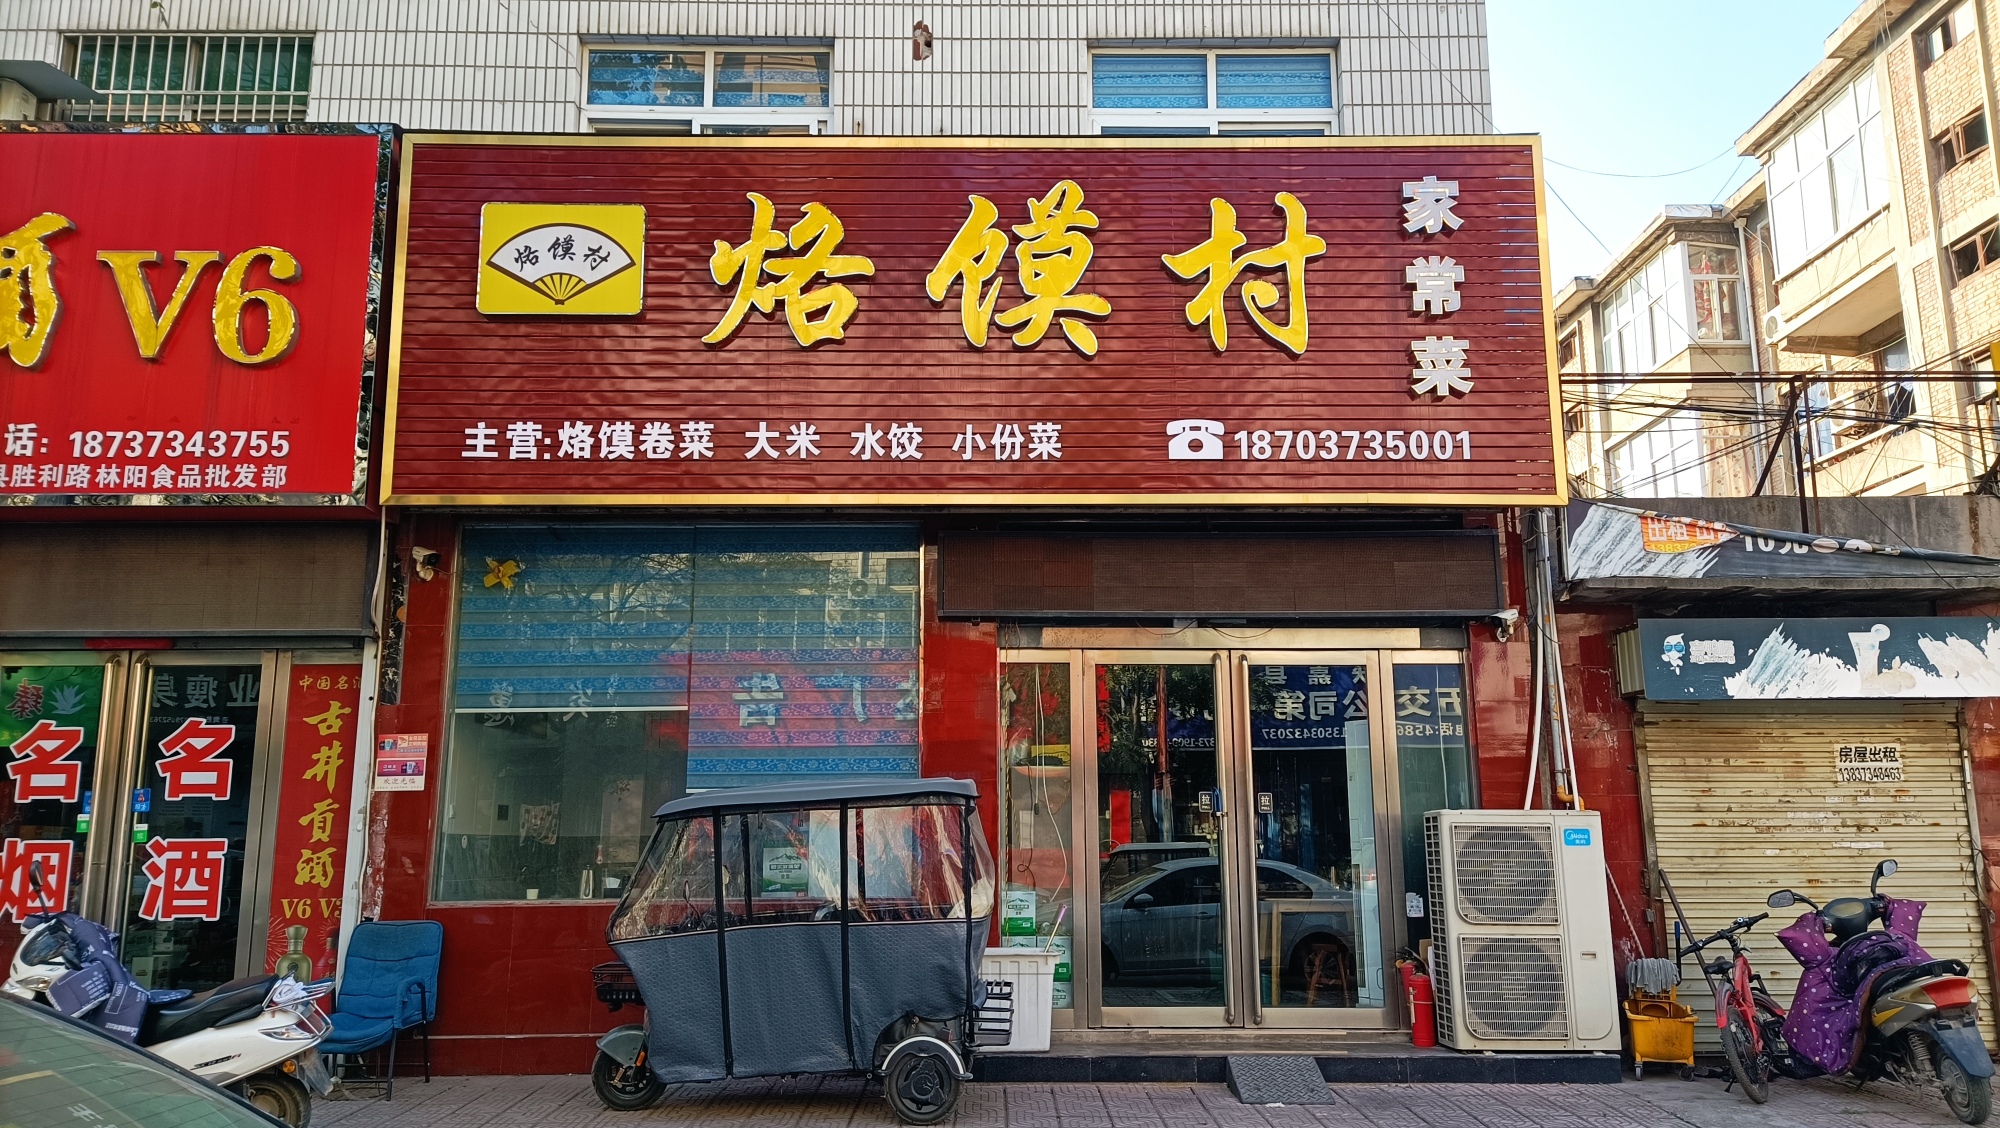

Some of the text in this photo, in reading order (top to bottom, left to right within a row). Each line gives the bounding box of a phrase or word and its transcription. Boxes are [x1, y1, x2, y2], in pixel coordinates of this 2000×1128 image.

[701, 179, 1327, 356] 烙馍村
[1402, 176, 1474, 397] 家常菜
[96, 245, 302, 366] V6
[69, 430, 290, 459] 18737343755
[744, 421, 821, 461] 大米
[850, 421, 924, 461] 水饺
[952, 421, 1063, 461] 小份菜
[1234, 429, 1472, 461] 18703735001
[1839, 746, 1898, 763] 房屋出租
[1839, 766, 1902, 782] 13837348463
[1201, 795, 1211, 805] 拉
[1260, 796, 1270, 806] 拉
[138, 717, 236, 922] 名酒
[281, 898, 312, 919] V6
